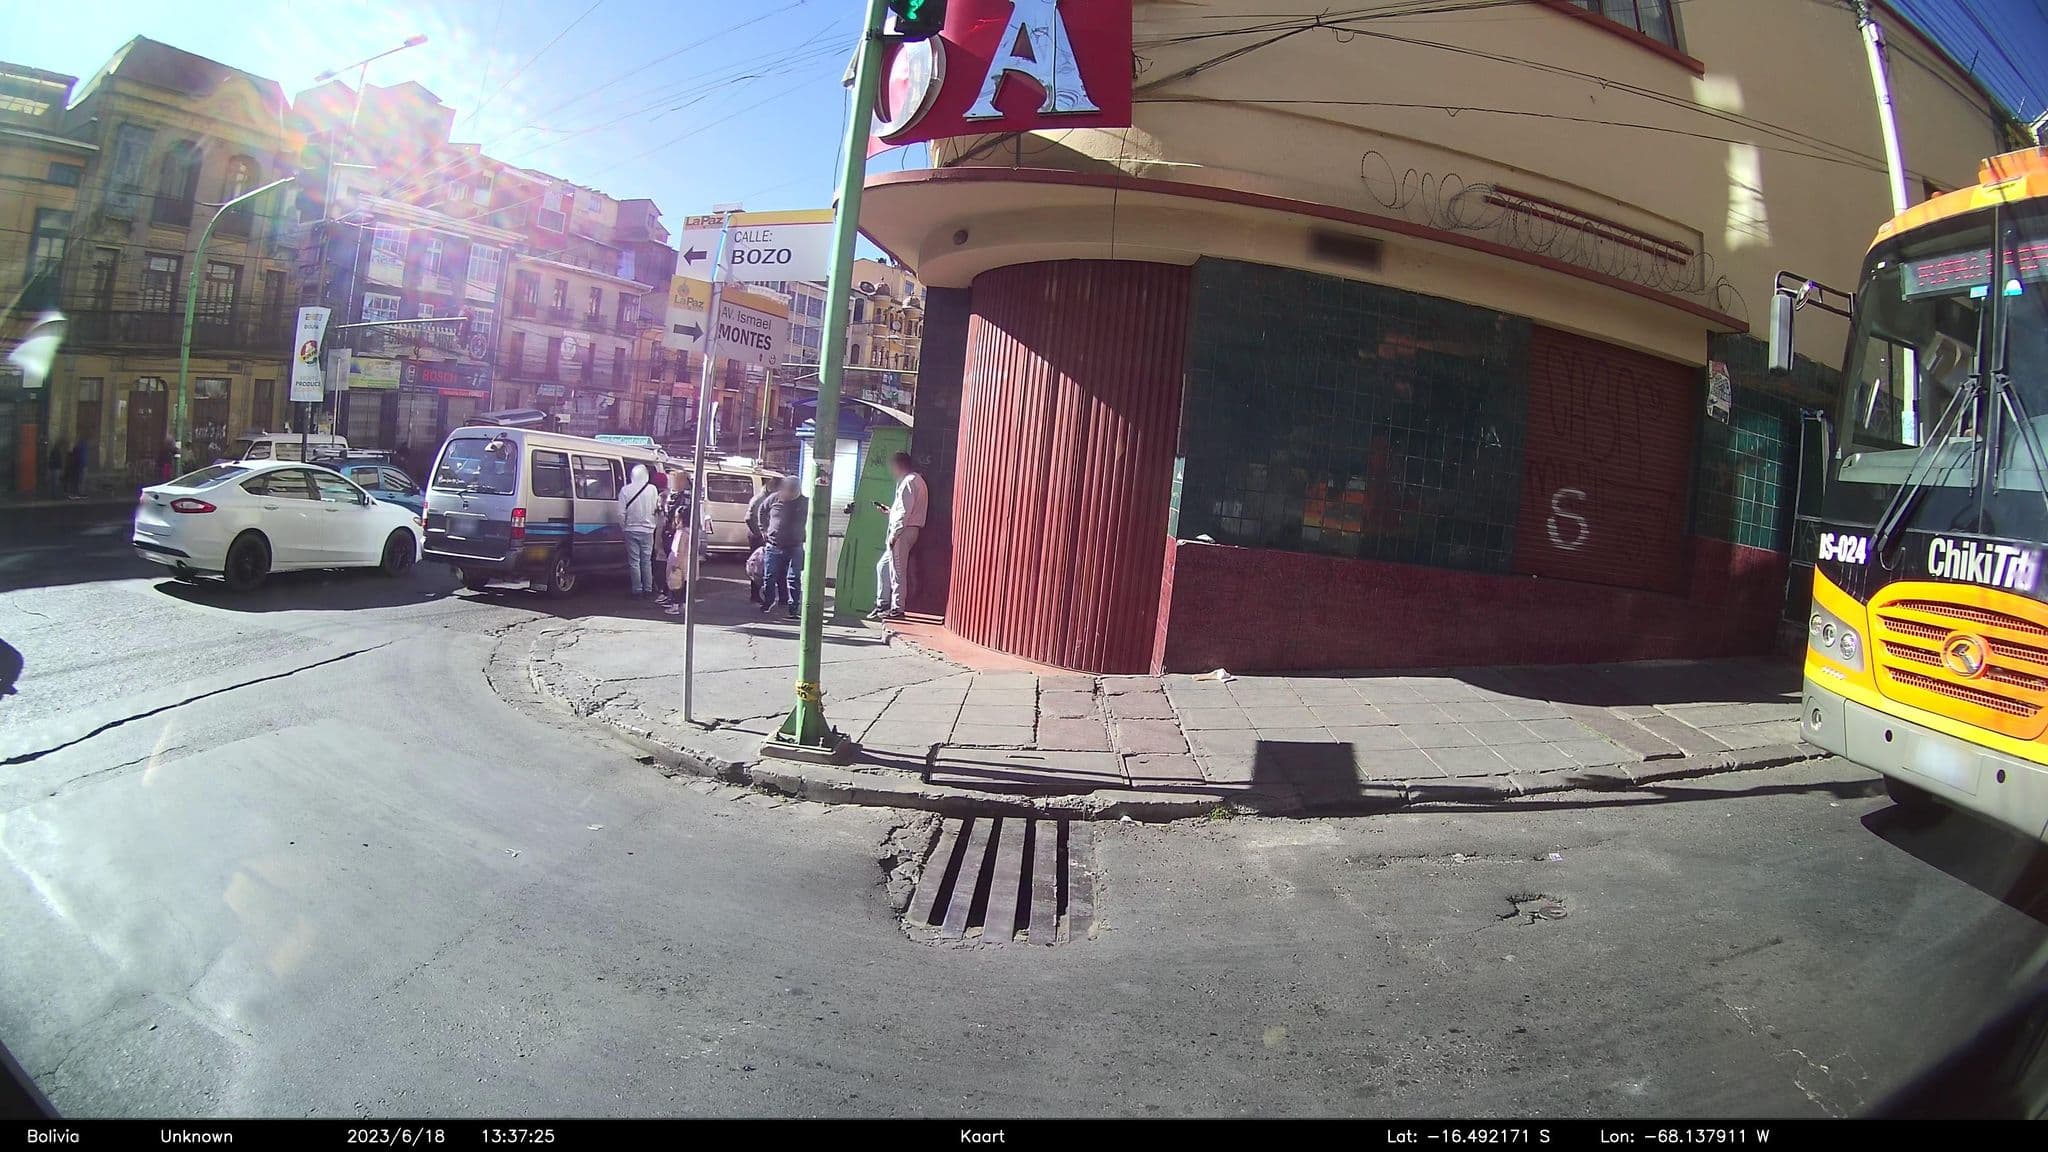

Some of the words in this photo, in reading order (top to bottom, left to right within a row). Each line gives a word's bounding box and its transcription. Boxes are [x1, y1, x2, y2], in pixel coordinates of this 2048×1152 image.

[734, 230, 773, 243] CALLE:
[731, 248, 792, 265] BOZO
[721, 306, 735, 320] AV.
[737, 310, 772, 331] Ismael
[718, 323, 772, 351] MONTES
